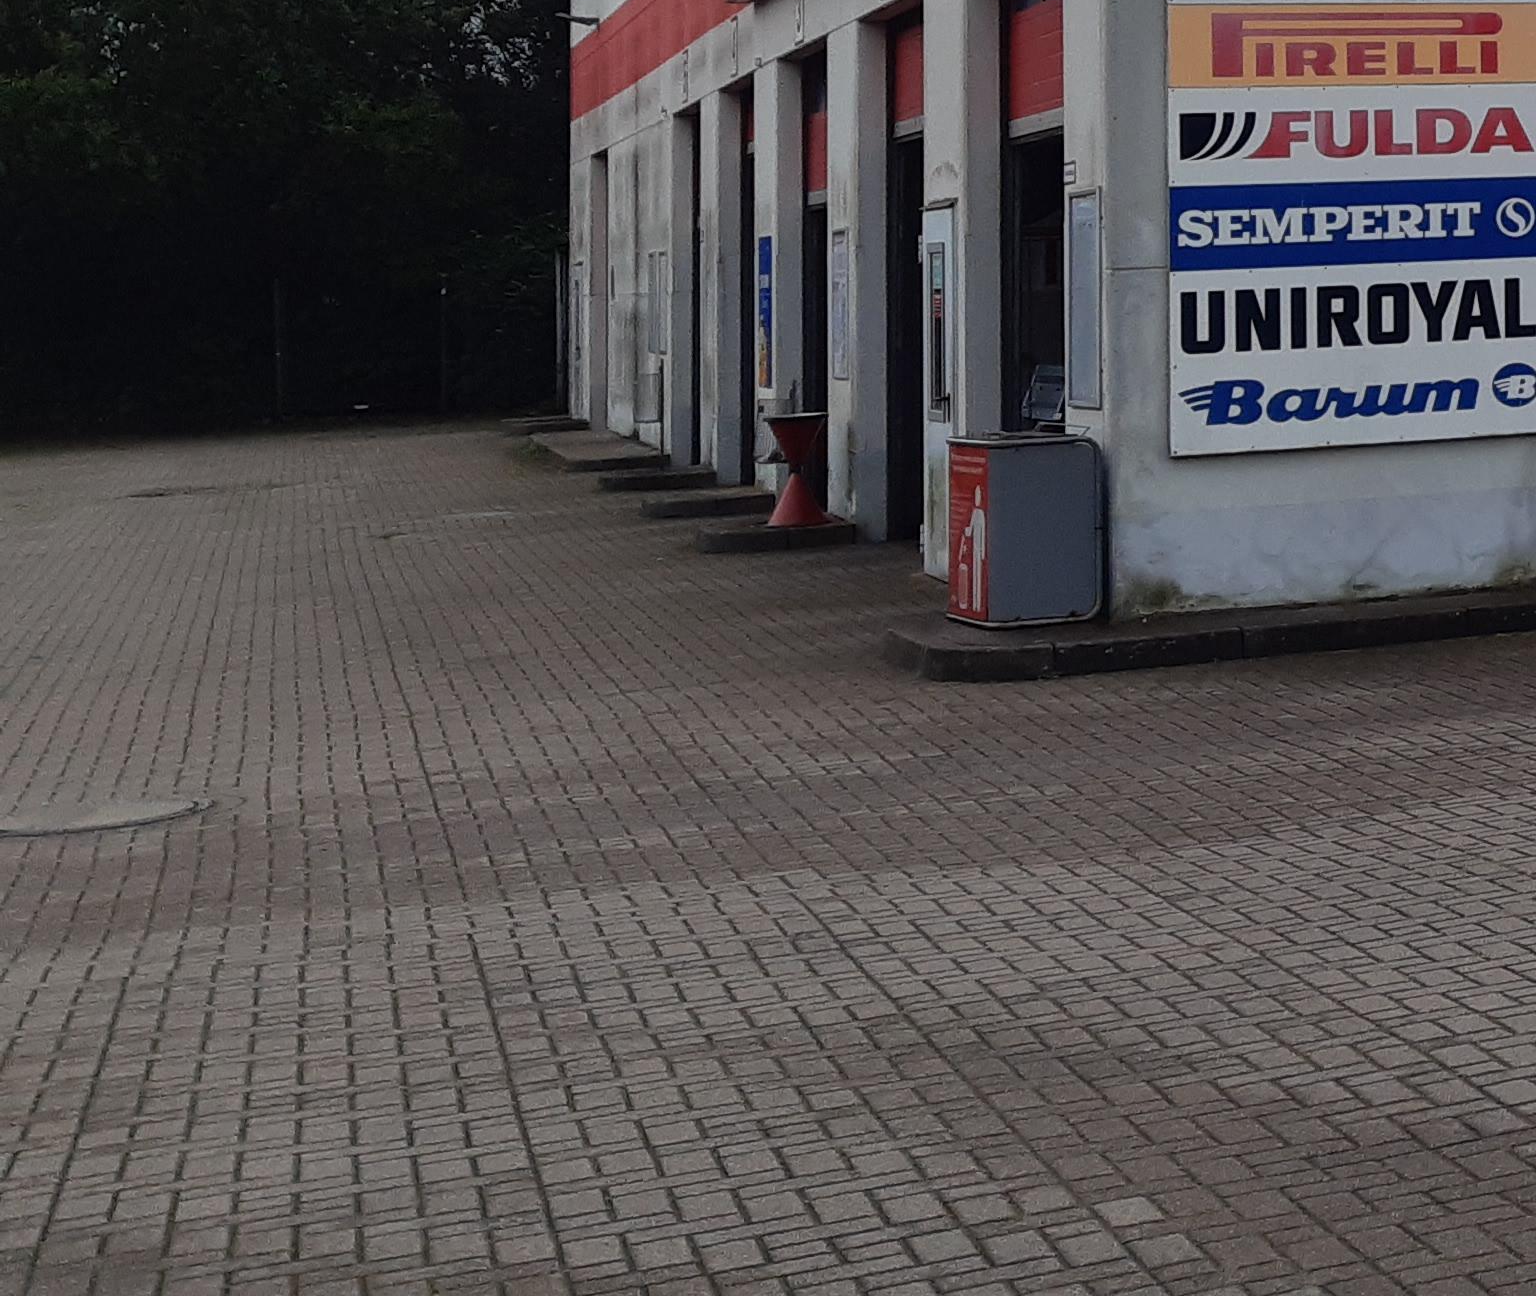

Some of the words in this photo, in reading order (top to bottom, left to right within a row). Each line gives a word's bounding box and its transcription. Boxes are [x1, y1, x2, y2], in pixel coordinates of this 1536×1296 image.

[1211, 12, 1503, 77] PIRELLI
[1242, 107, 1535, 160] FULDA
[1177, 202, 1481, 248] SEMPERIT
[1178, 379, 1480, 426] Barum
